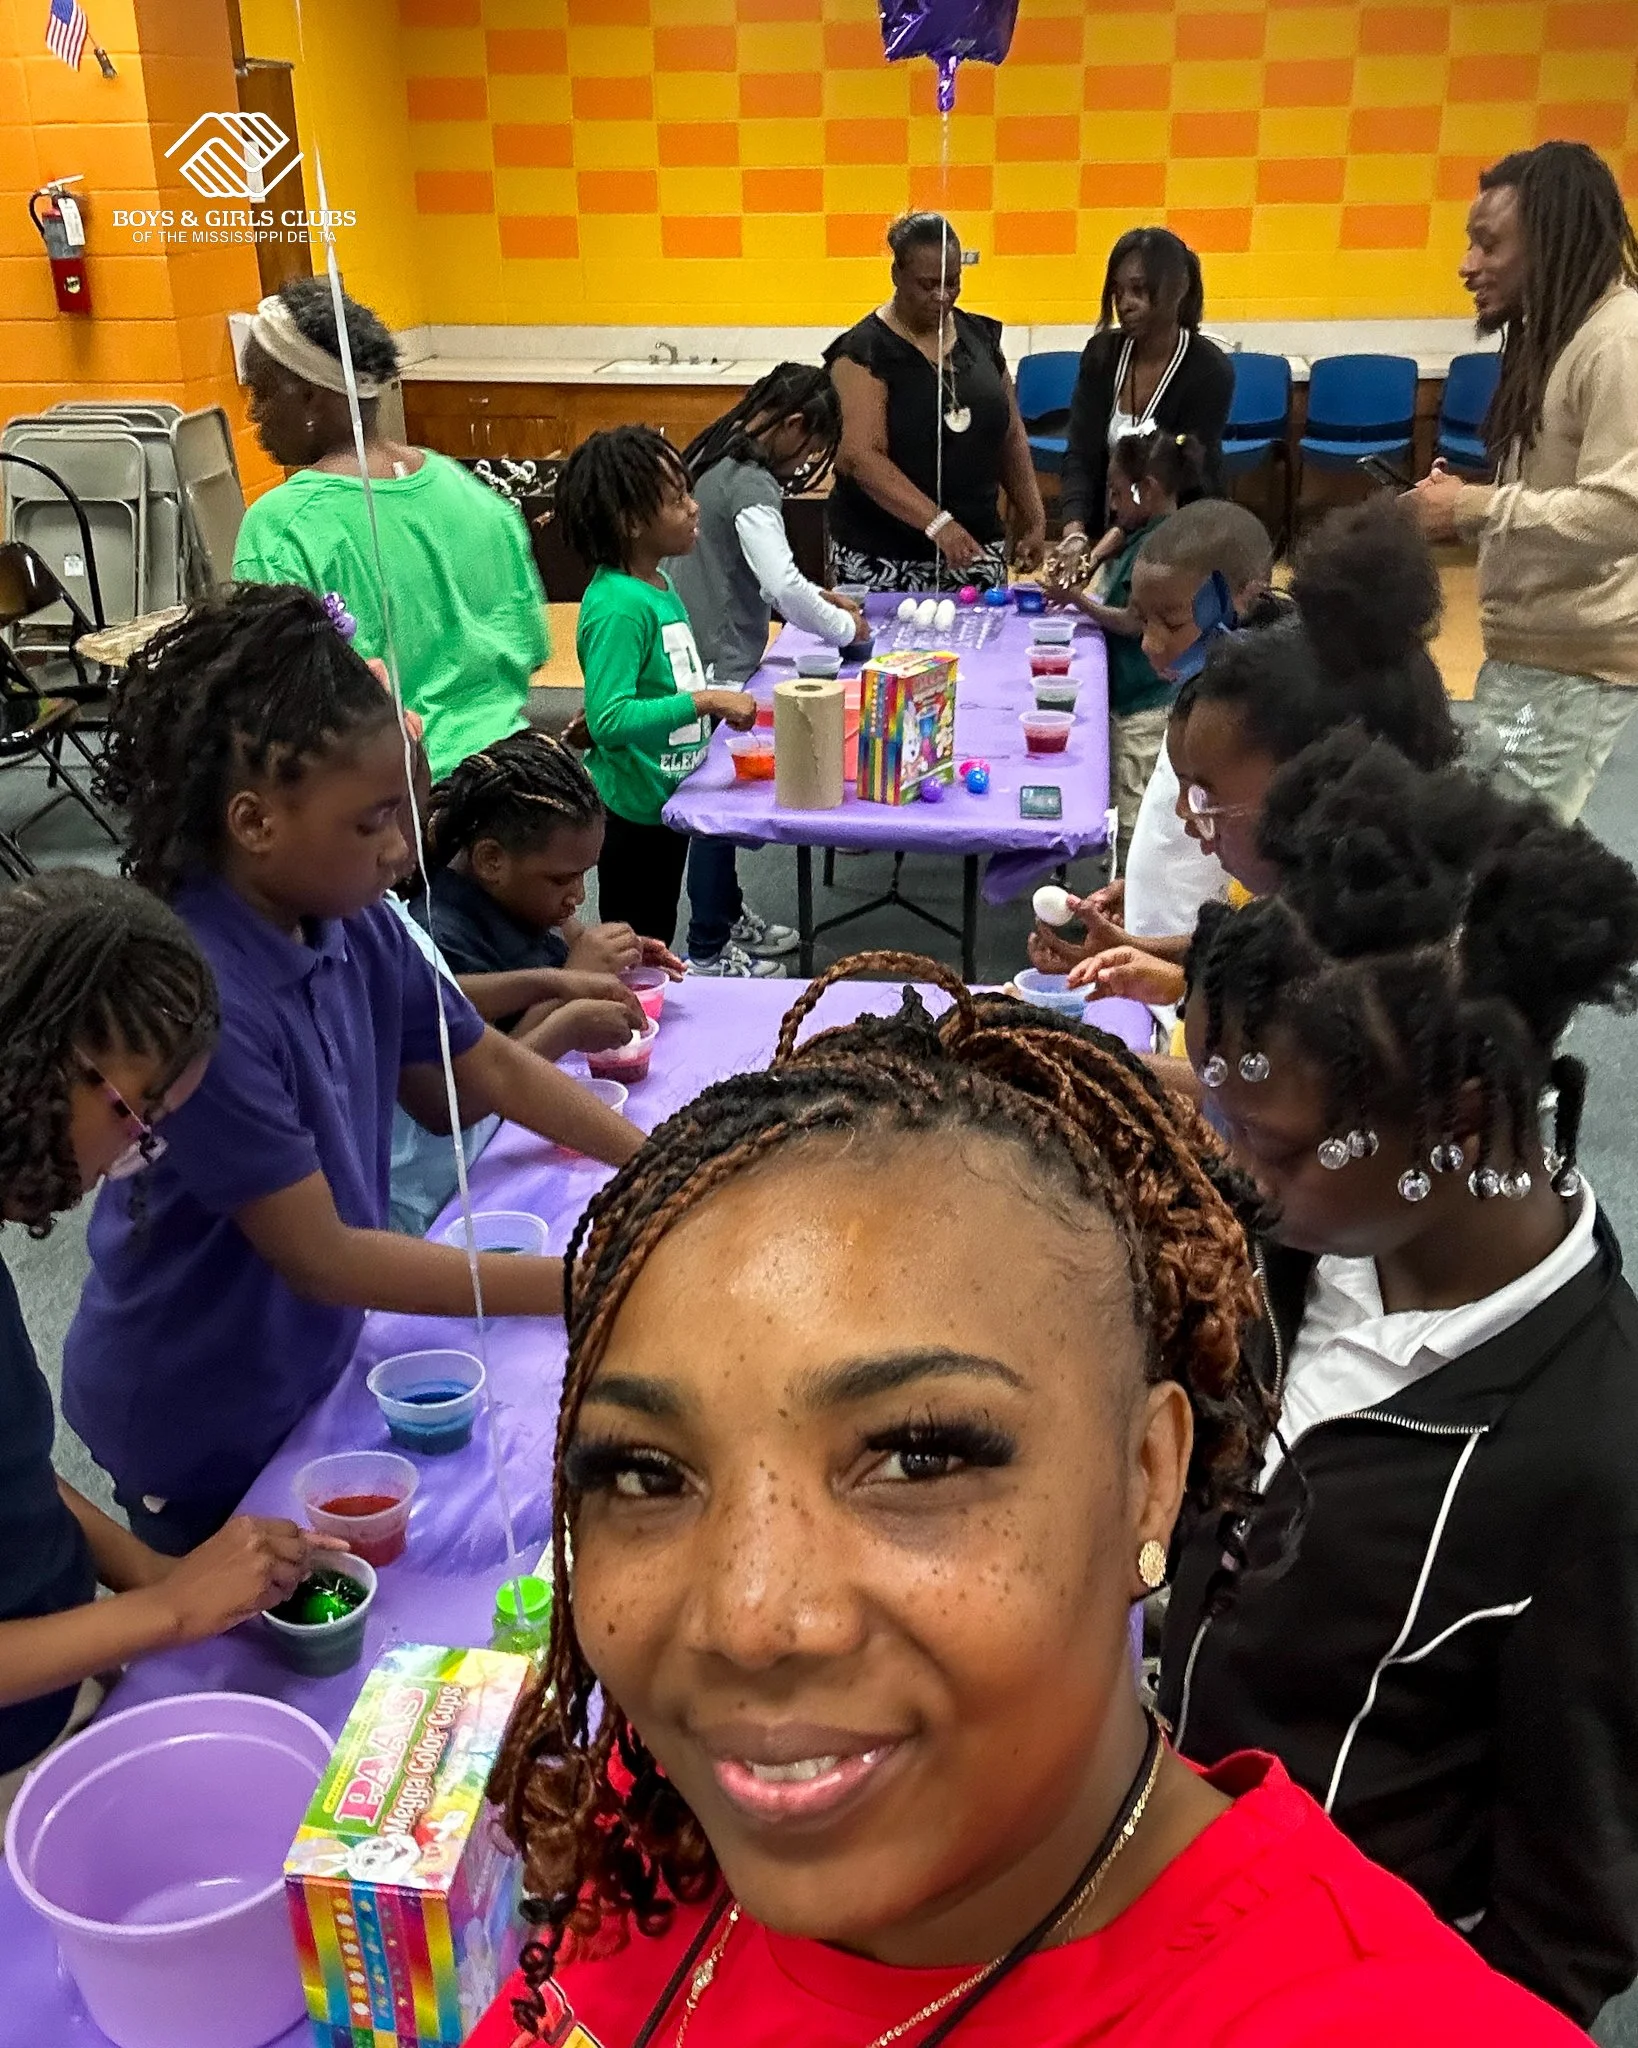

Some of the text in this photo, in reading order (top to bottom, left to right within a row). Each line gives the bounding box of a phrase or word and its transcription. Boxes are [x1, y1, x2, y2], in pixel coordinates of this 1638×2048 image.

[426, 1686, 464, 1728] Cups
[334, 1686, 430, 1827] PAAS
[407, 1726, 448, 1775] Color
